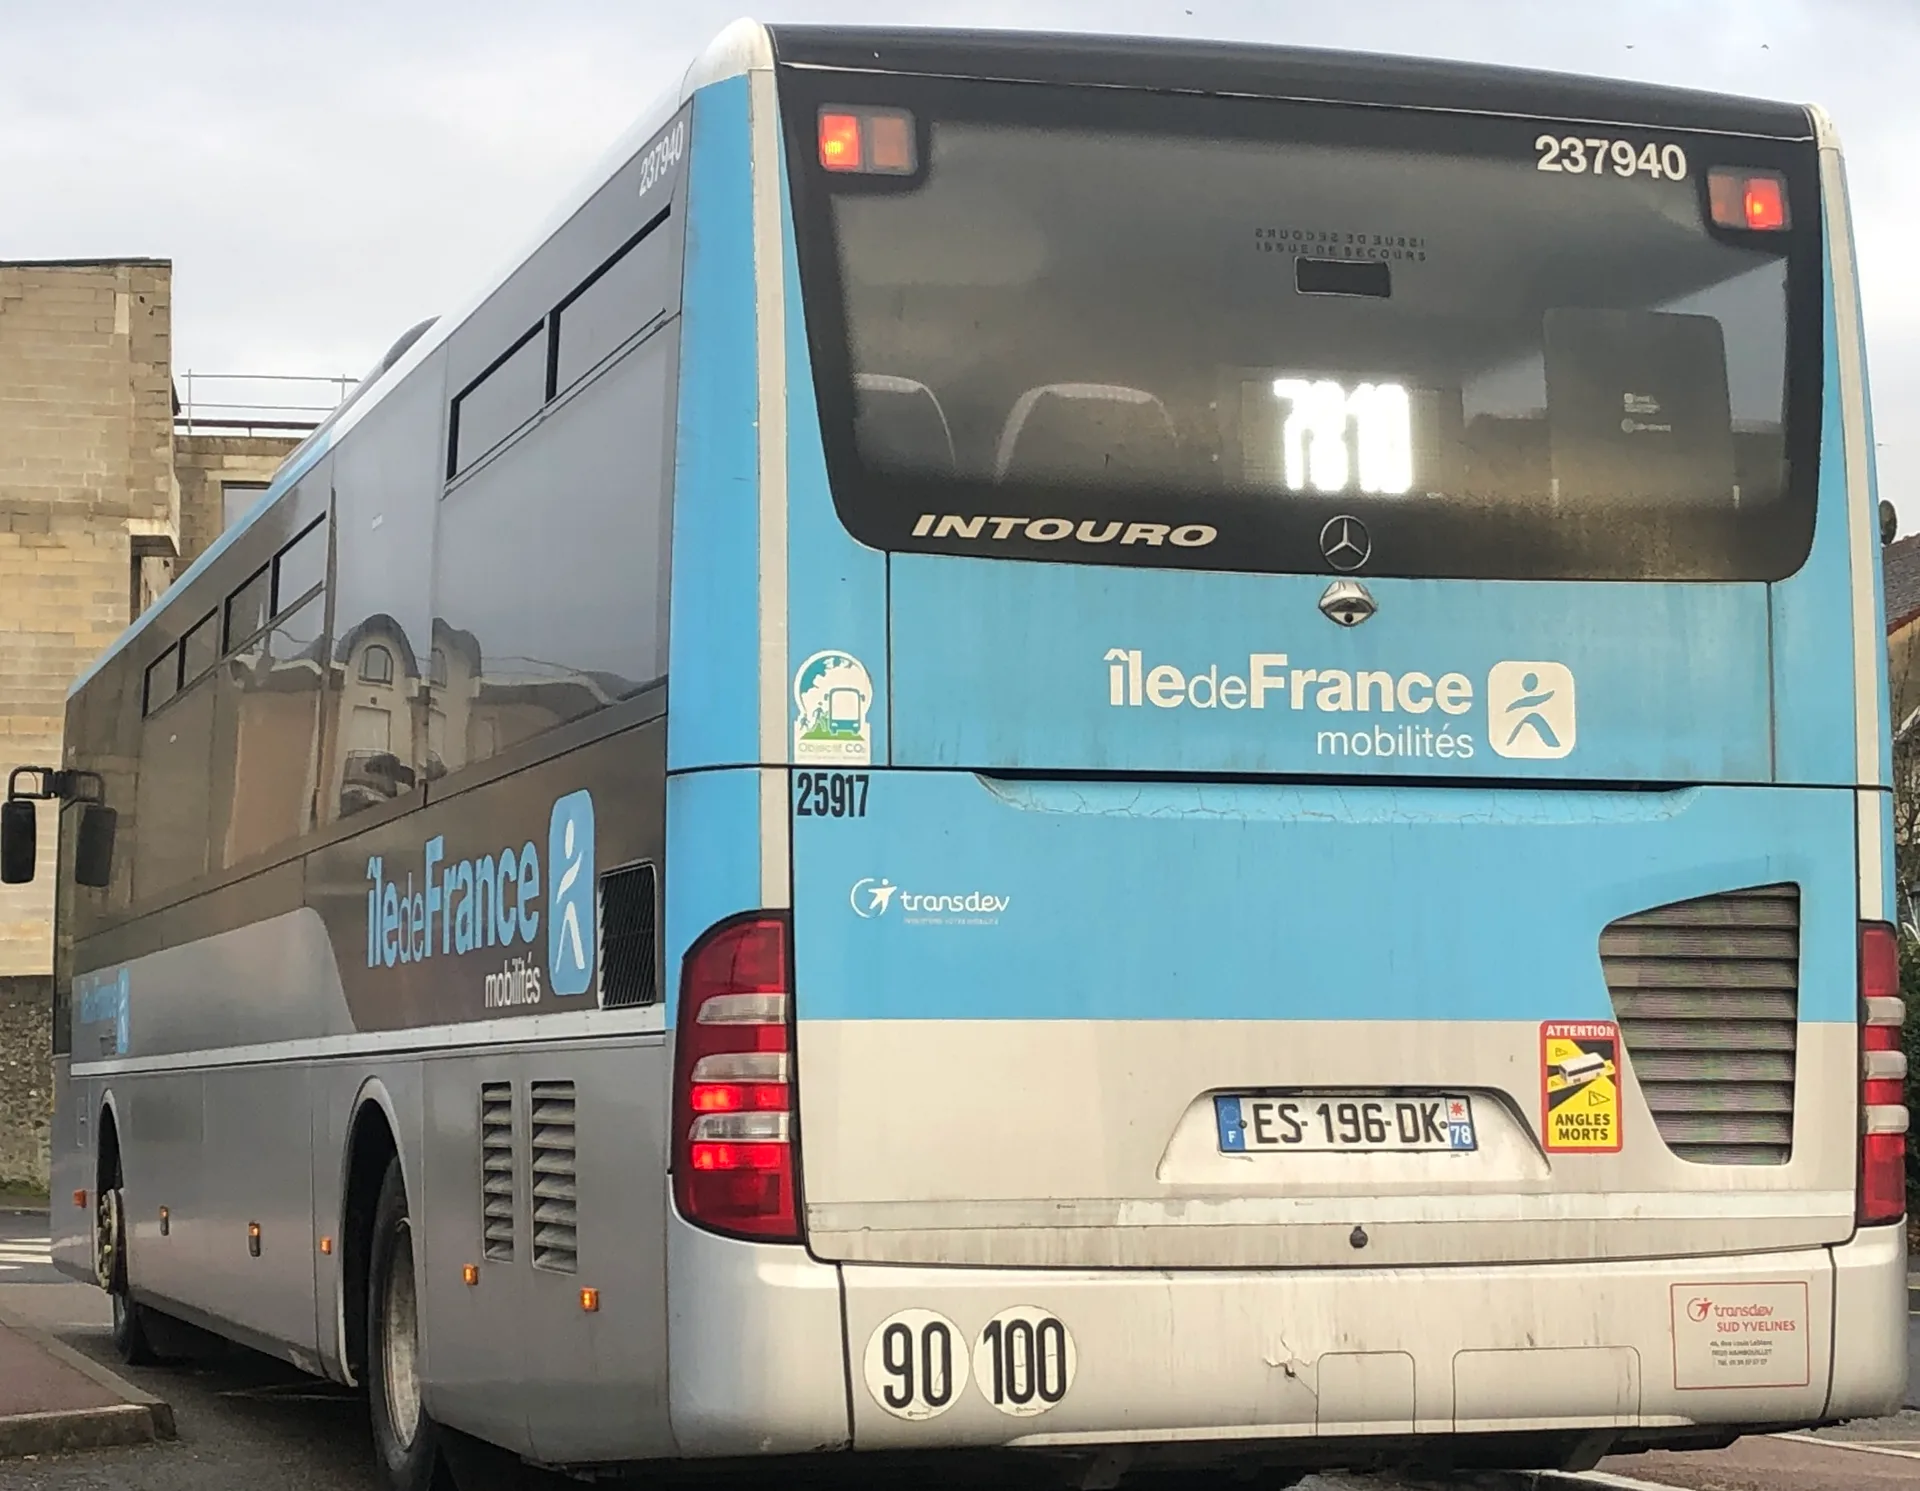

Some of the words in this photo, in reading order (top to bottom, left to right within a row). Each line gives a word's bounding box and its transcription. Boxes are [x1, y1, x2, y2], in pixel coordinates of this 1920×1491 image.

[638, 121, 684, 197] 237940
[1534, 134, 1688, 182] 237940
[911, 514, 1218, 547] INTOURO
[1316, 723, 1474, 759] mobilités
[796, 772, 870, 818] 25917
[900, 890, 1010, 912] transdev
[485, 951, 541, 1008] mobilités
[1546, 1024, 1615, 1037] ATTENTION
[1227, 1130, 1237, 1144] F
[1450, 1124, 1472, 1145] 78
[1555, 1113, 1611, 1126] ANGLES
[1558, 1128, 1609, 1141] MORTS
[1713, 1304, 1774, 1317] transdev
[1716, 1321, 1740, 1333] SUD
[1742, 1320, 1796, 1332] YVELINES
[882, 1321, 953, 1409] 90
[983, 1317, 1067, 1405] 100
